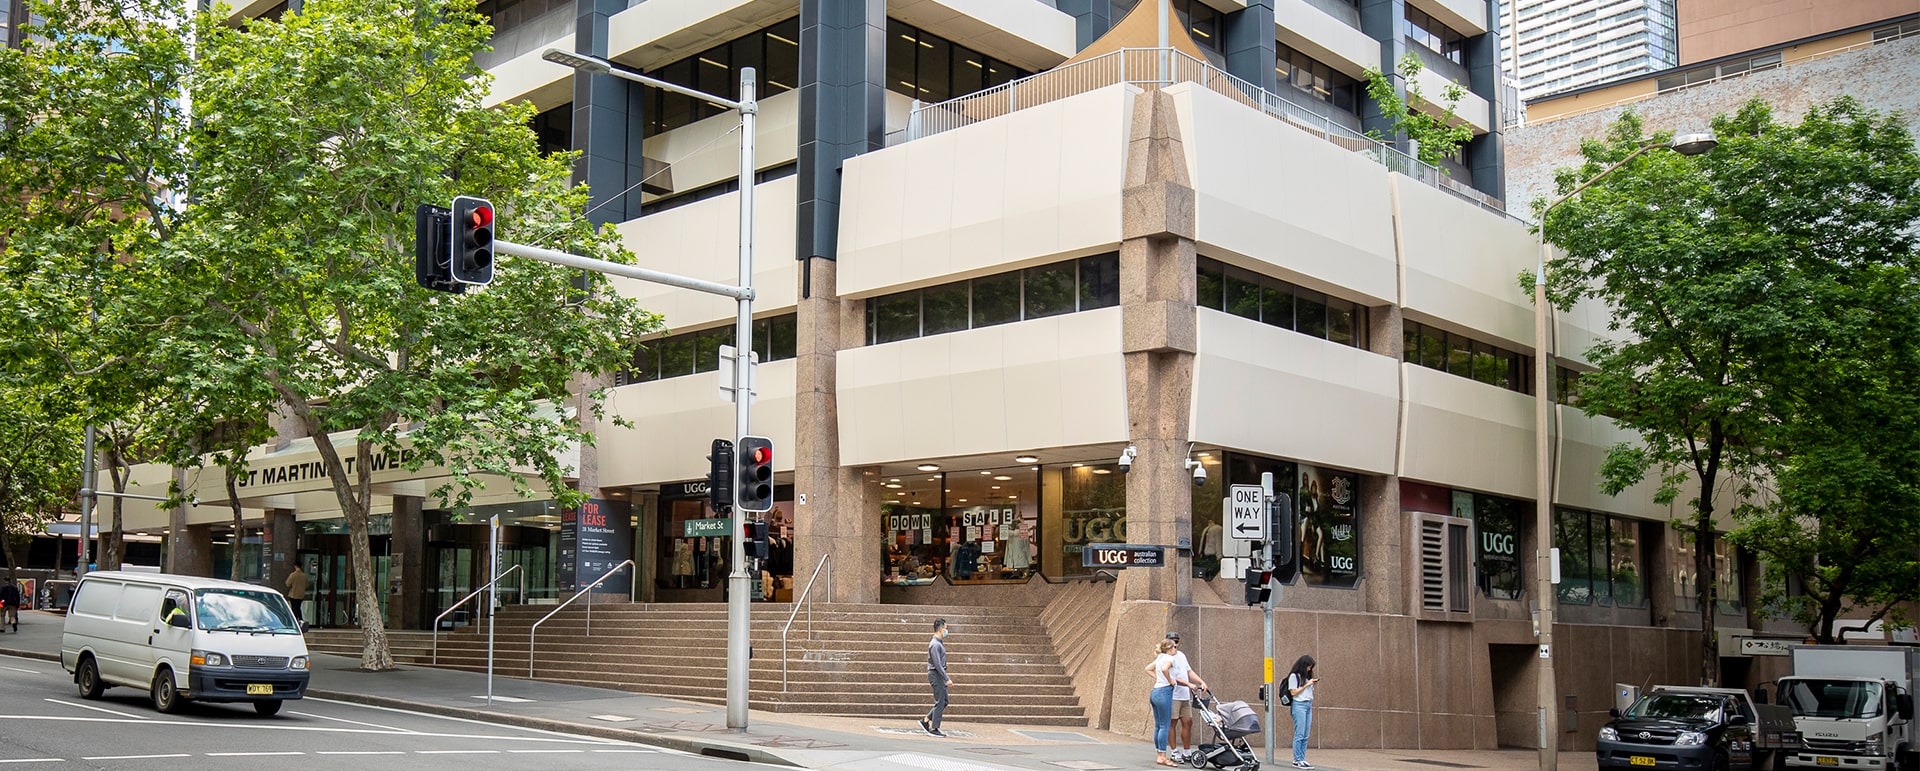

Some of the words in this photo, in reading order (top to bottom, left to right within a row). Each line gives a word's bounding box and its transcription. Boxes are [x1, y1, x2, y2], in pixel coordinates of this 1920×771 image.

[262, 461, 331, 485] MARTIN
[684, 482, 706, 493] UGG
[1236, 490, 1259, 503] ONE
[582, 502, 599, 515] FOR
[1234, 506, 1260, 519] WAY
[582, 514, 607, 526] LEASE
[695, 521, 716, 530] Market
[717, 520, 724, 530] St
[891, 516, 931, 529] DOWN
[963, 510, 1013, 525] SALE
[1482, 531, 1515, 555] UGG
[1098, 550, 1128, 564] UGG
[1331, 556, 1353, 570] UGG
